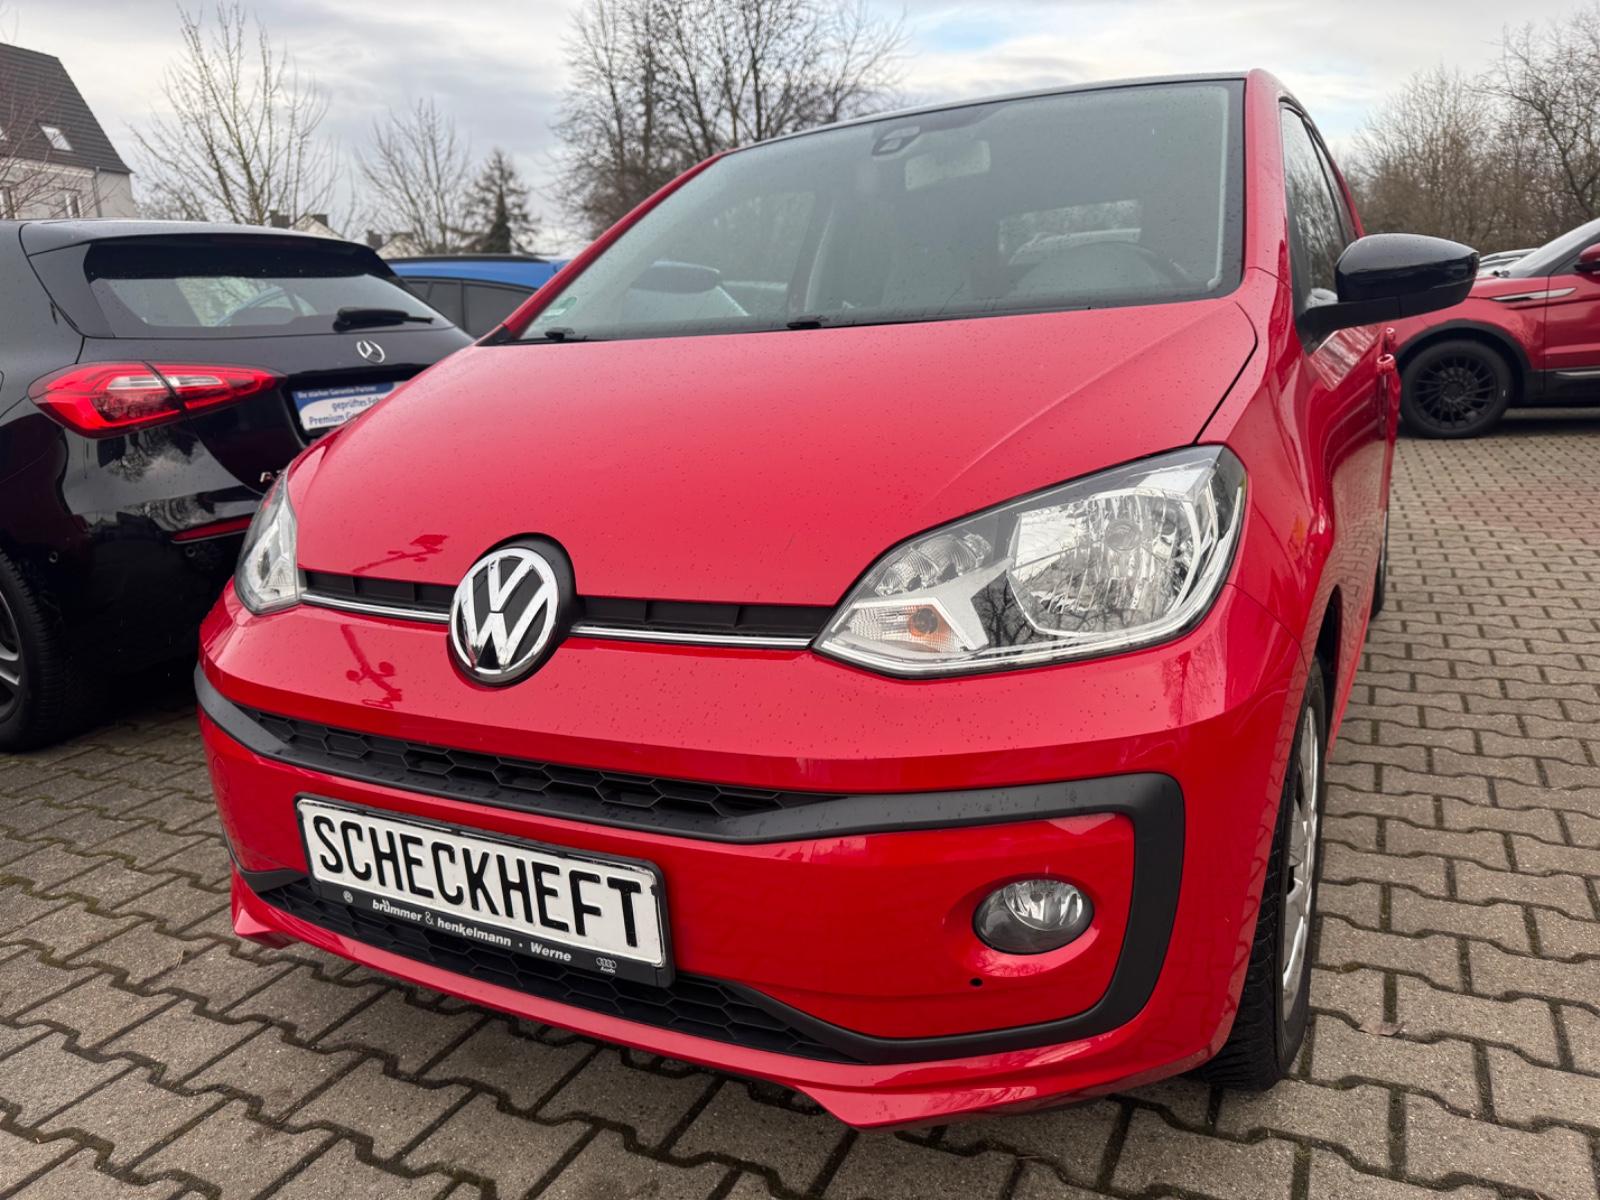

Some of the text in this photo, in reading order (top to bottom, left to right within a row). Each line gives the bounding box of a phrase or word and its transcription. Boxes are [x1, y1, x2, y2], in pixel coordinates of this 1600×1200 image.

[309, 415, 344, 425] Premium
[313, 815, 642, 948] SCHECKHEFT
[372, 899, 572, 962] brümmer & henkelmann Werne
